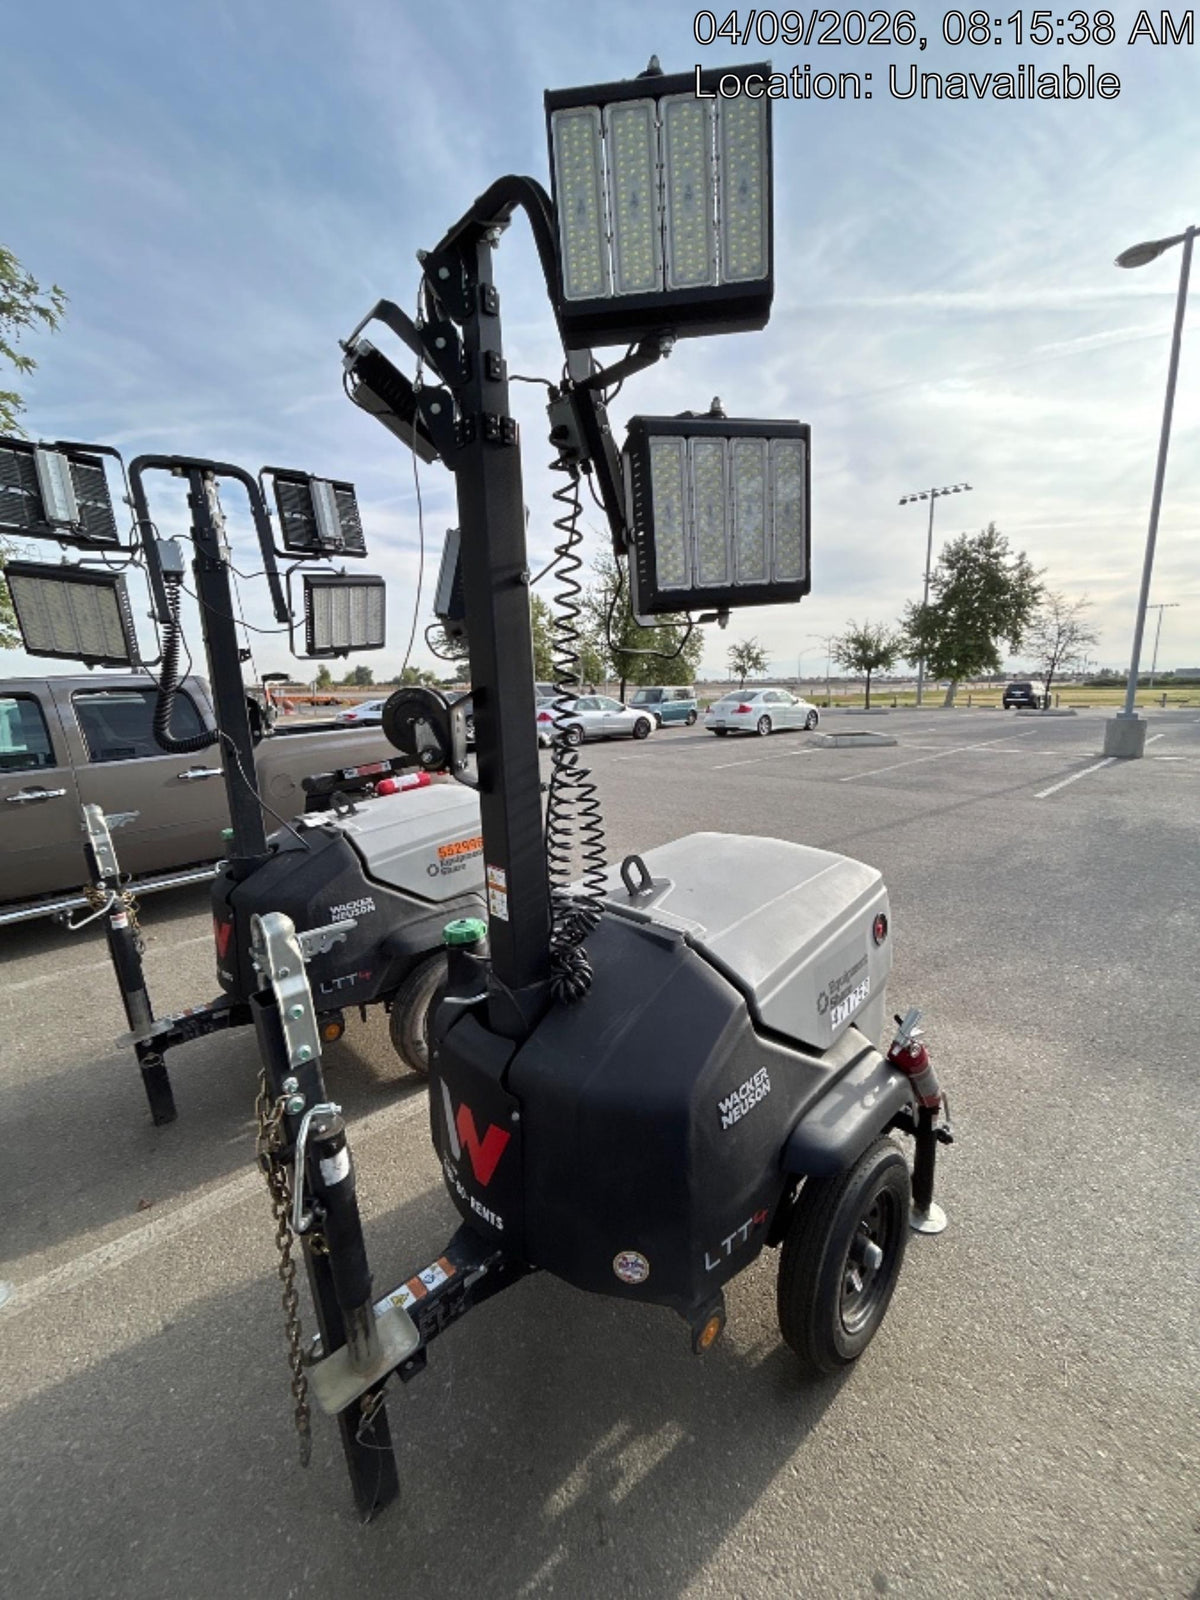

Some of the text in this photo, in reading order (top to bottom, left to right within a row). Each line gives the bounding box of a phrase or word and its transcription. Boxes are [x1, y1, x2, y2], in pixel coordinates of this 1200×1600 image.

[329, 897, 374, 914] WACKER
[331, 905, 376, 922] NEUSON
[718, 1066, 769, 1113] WACKER
[721, 1078, 771, 1130] NEUSON
